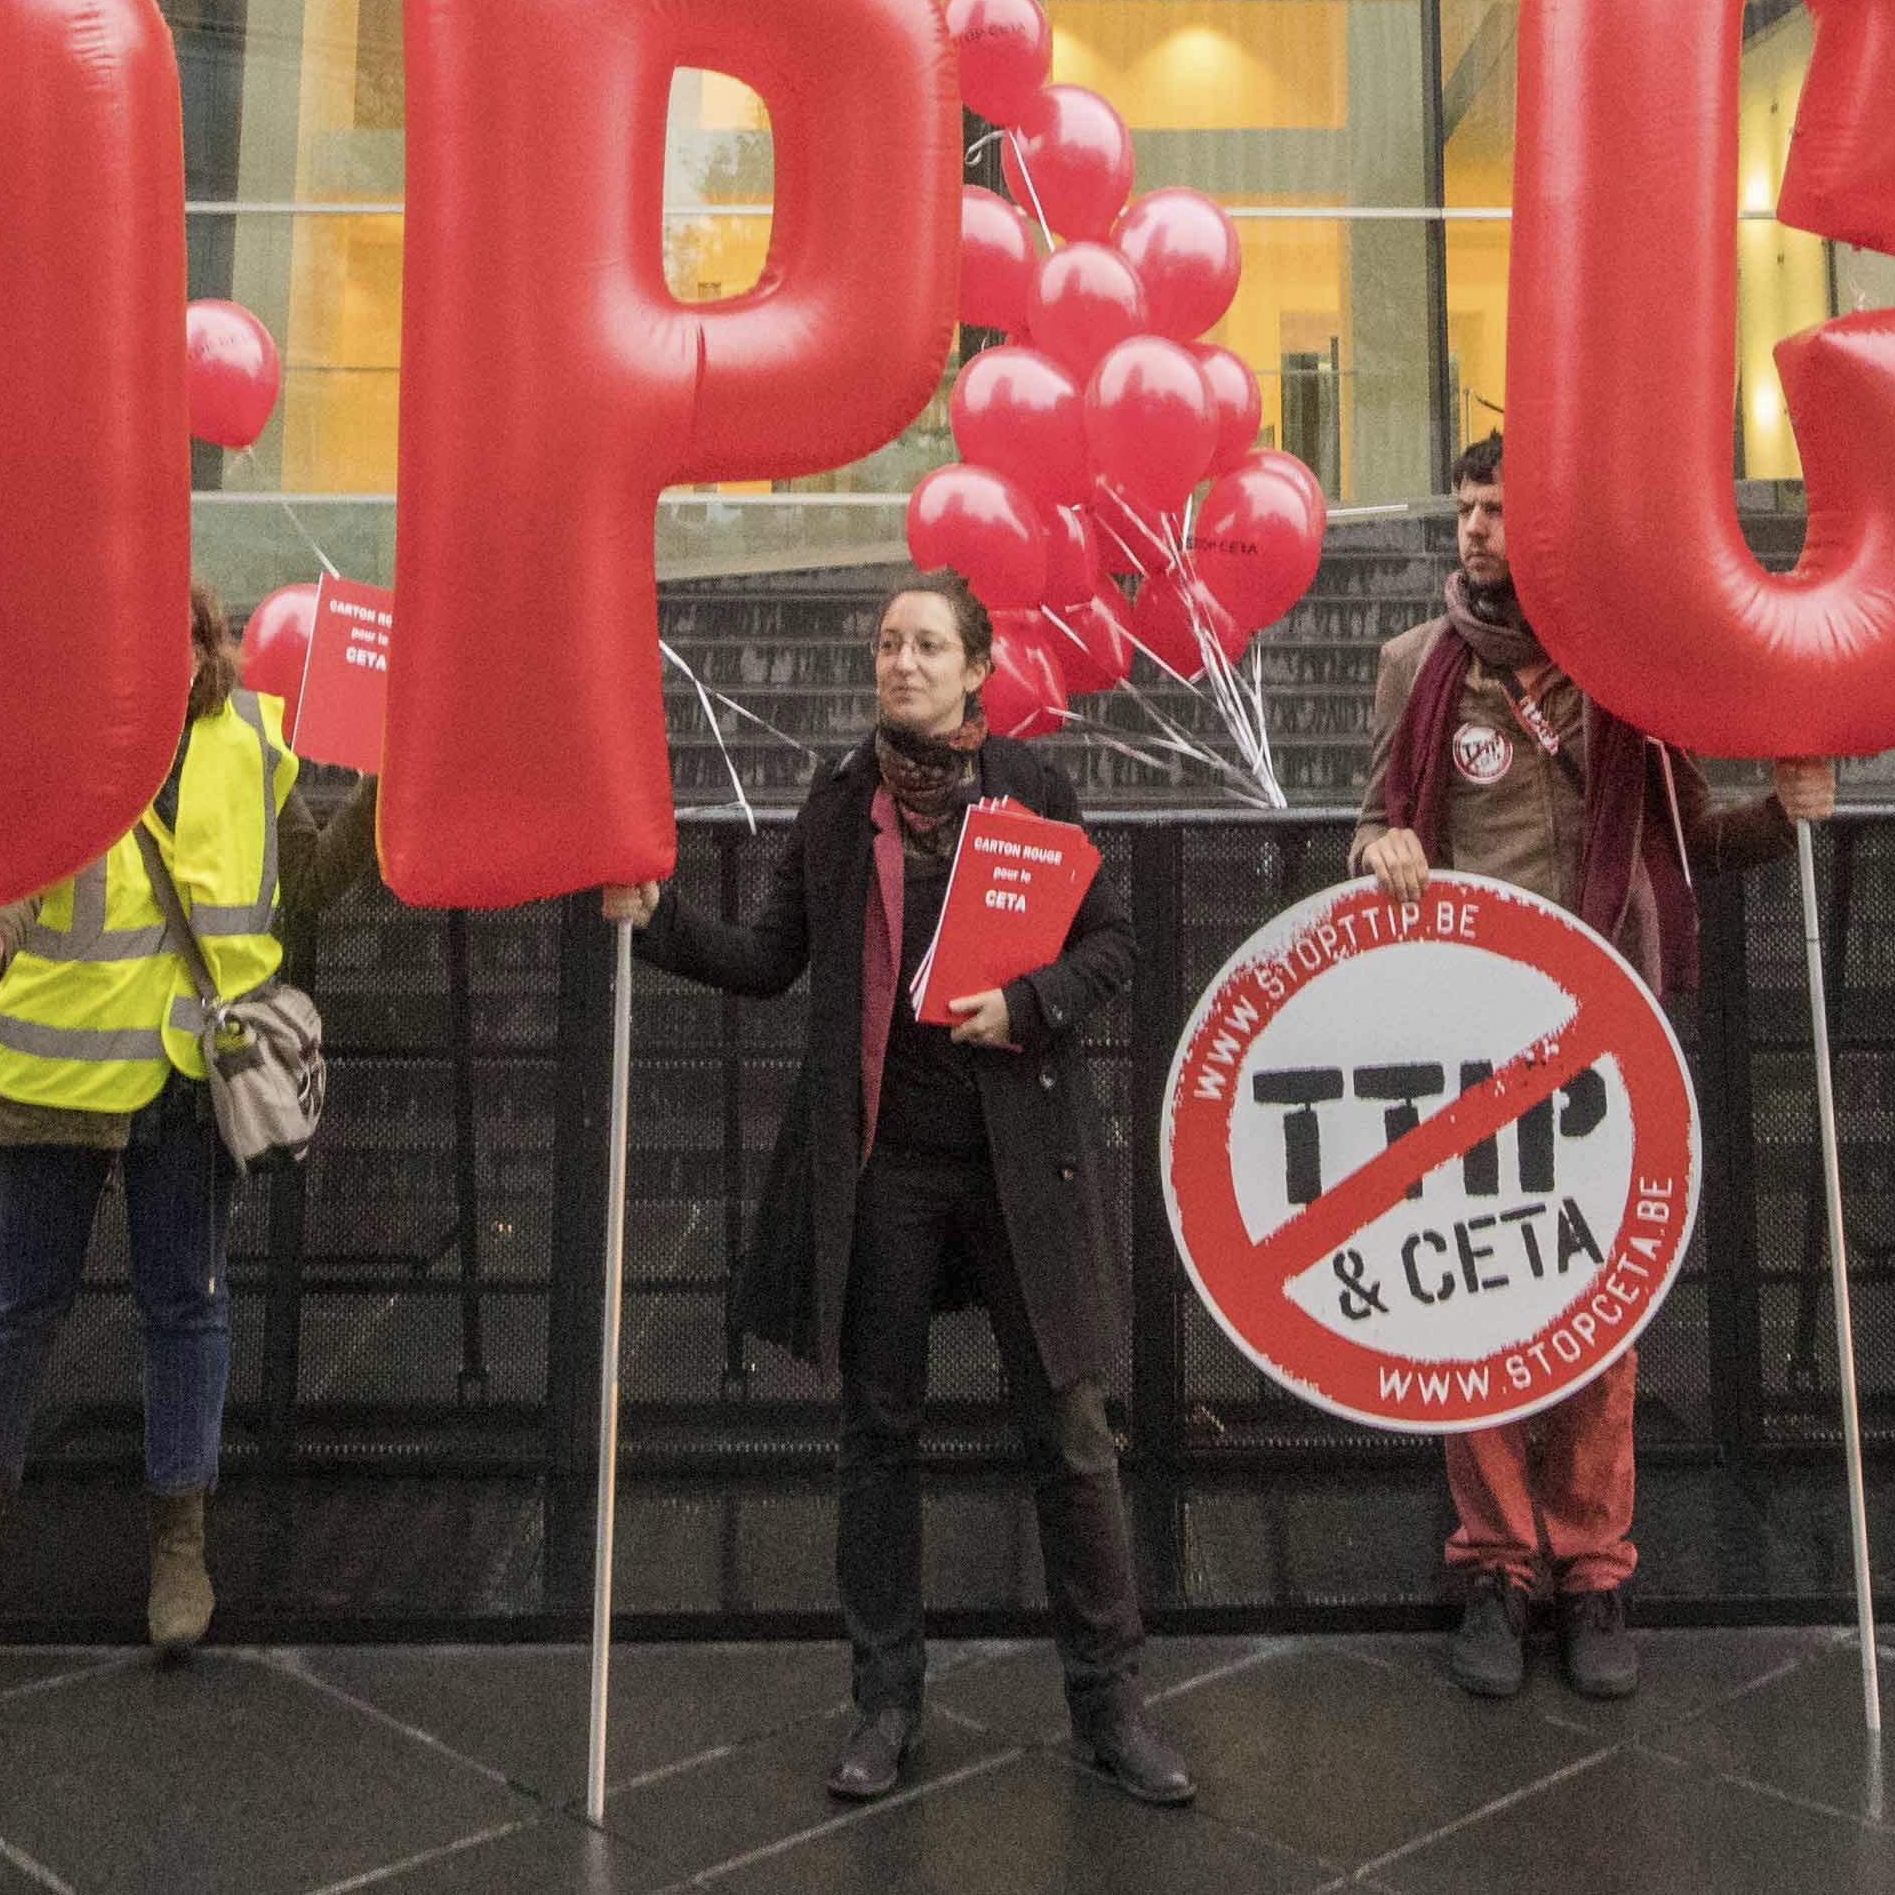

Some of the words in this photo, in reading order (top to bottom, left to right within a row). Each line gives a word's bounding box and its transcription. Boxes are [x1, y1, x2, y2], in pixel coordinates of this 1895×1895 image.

[329, 598, 376, 623] CARTON
[345, 646, 387, 672] CETA
[974, 836, 1021, 859] CARTON
[1022, 845, 1063, 865] ROUGE
[993, 866, 1019, 881] pour
[985, 889, 1026, 913] CETA
[1252, 1058, 1608, 1206] TTIP
[1331, 1245, 1390, 1322] &
[1400, 1195, 1606, 1305] CETA
